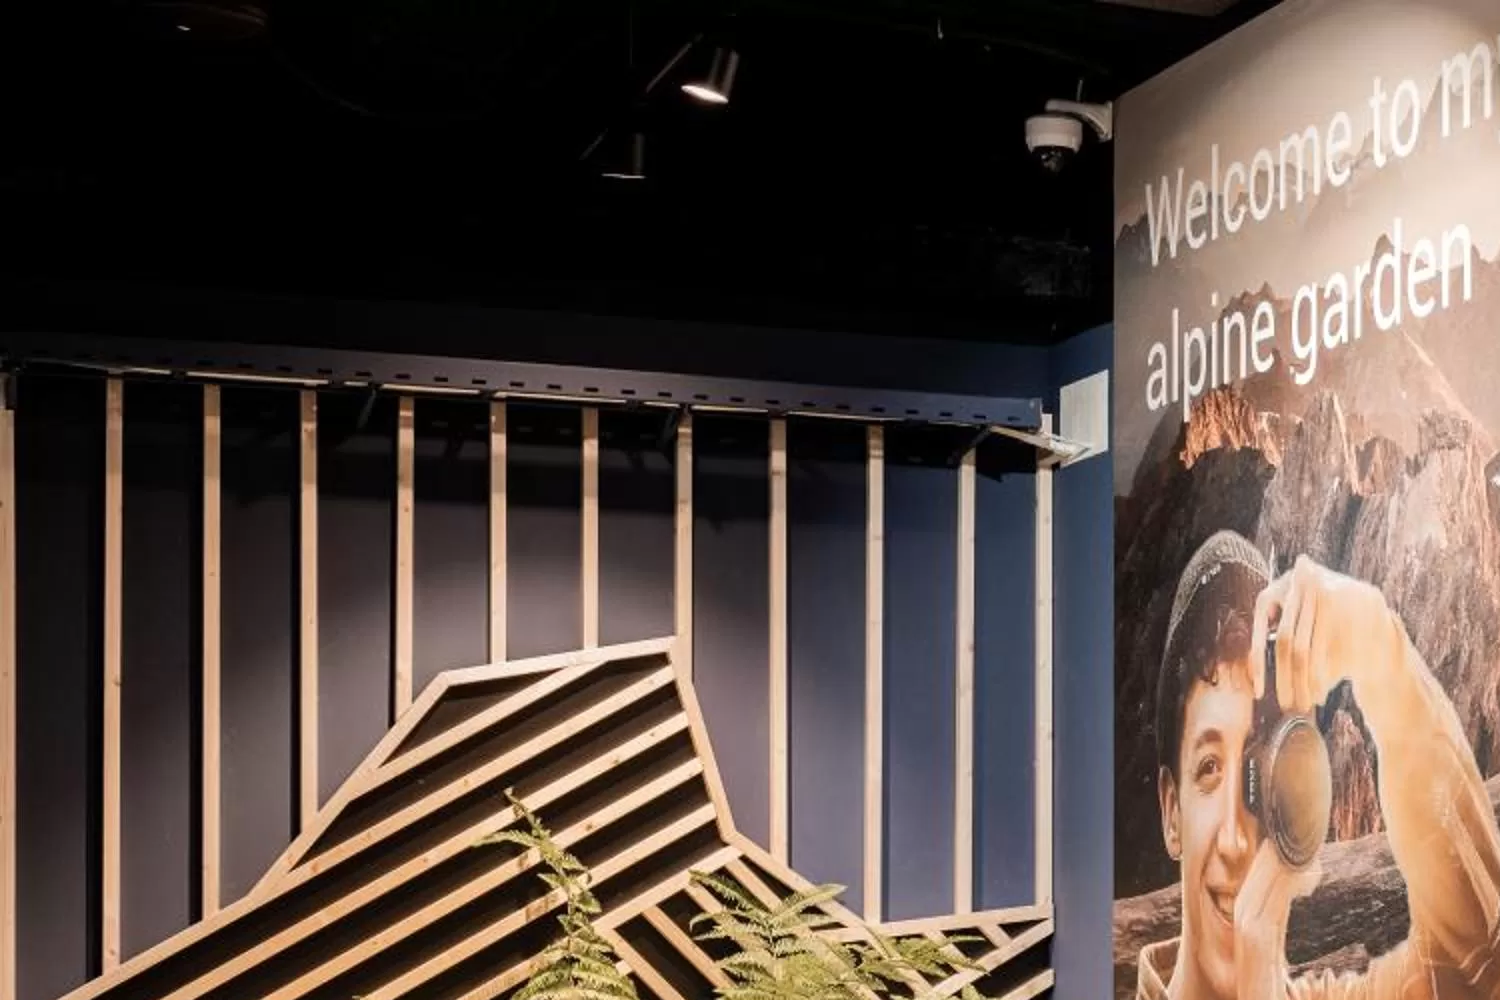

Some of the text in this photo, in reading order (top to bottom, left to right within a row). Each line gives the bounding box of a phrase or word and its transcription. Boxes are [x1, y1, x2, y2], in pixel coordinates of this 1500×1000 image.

[1145, 110, 1351, 266] Welcome
[1369, 77, 1421, 168] to
[1146, 217, 1472, 422] alpine garden
